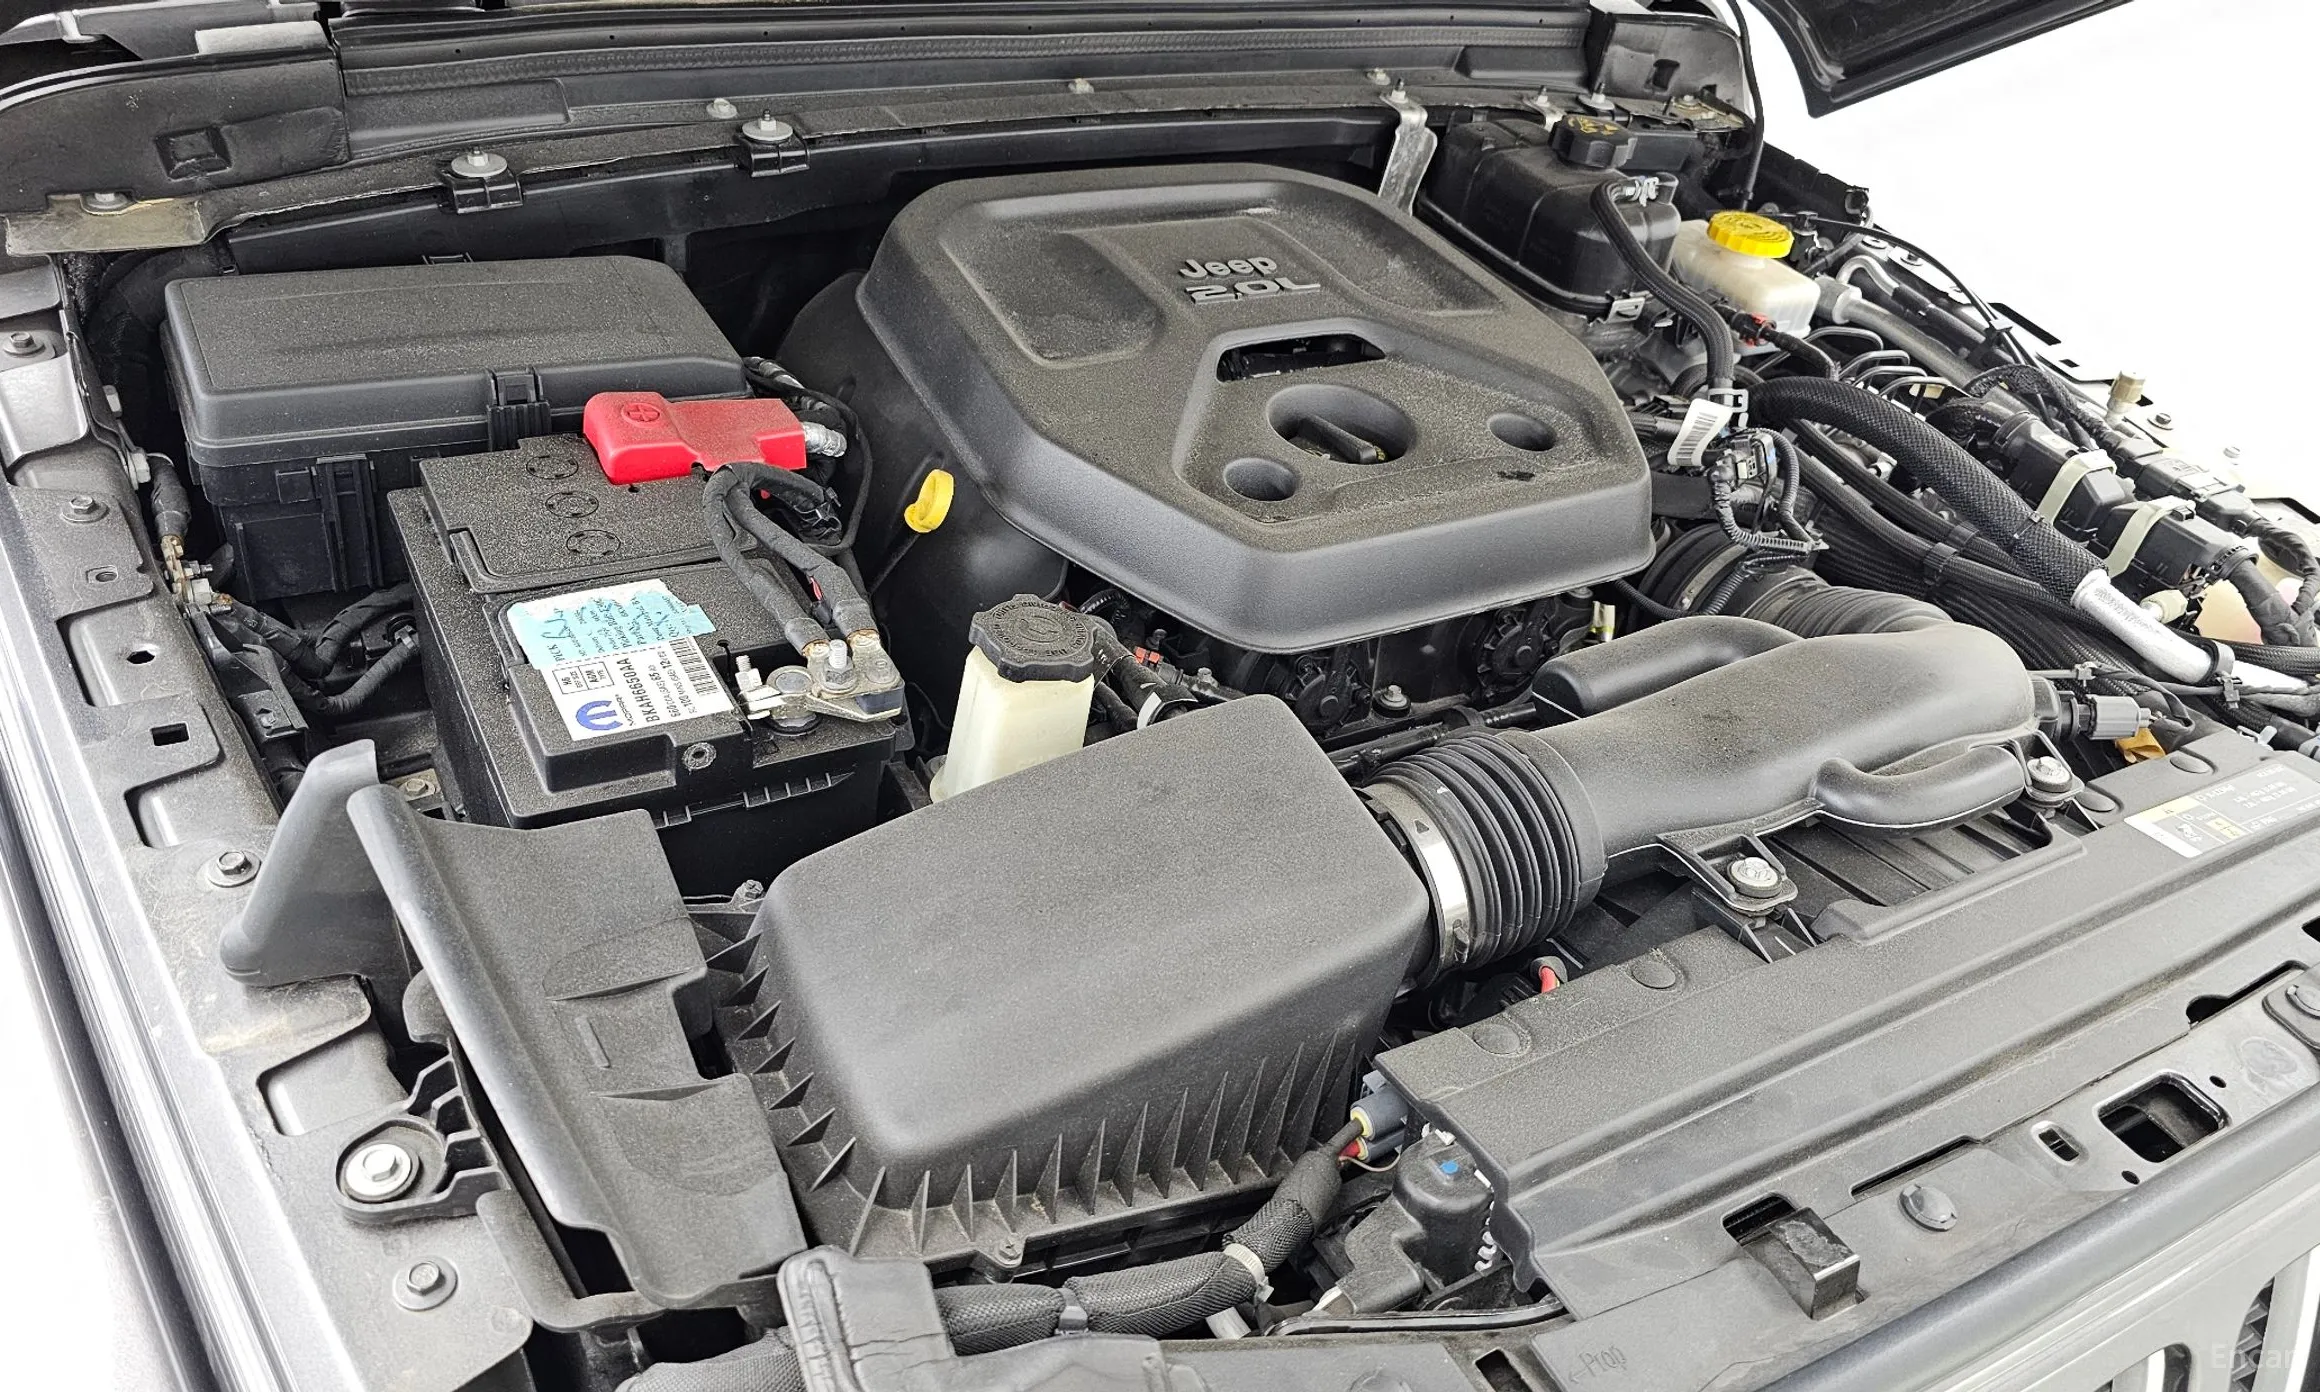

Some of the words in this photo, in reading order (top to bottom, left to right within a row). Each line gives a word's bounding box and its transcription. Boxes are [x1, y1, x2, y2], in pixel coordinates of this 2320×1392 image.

[1178, 256, 1277, 279] Jeep
[1185, 277, 1321, 305] 2.0L
[615, 657, 660, 722] BKAH6650AA
